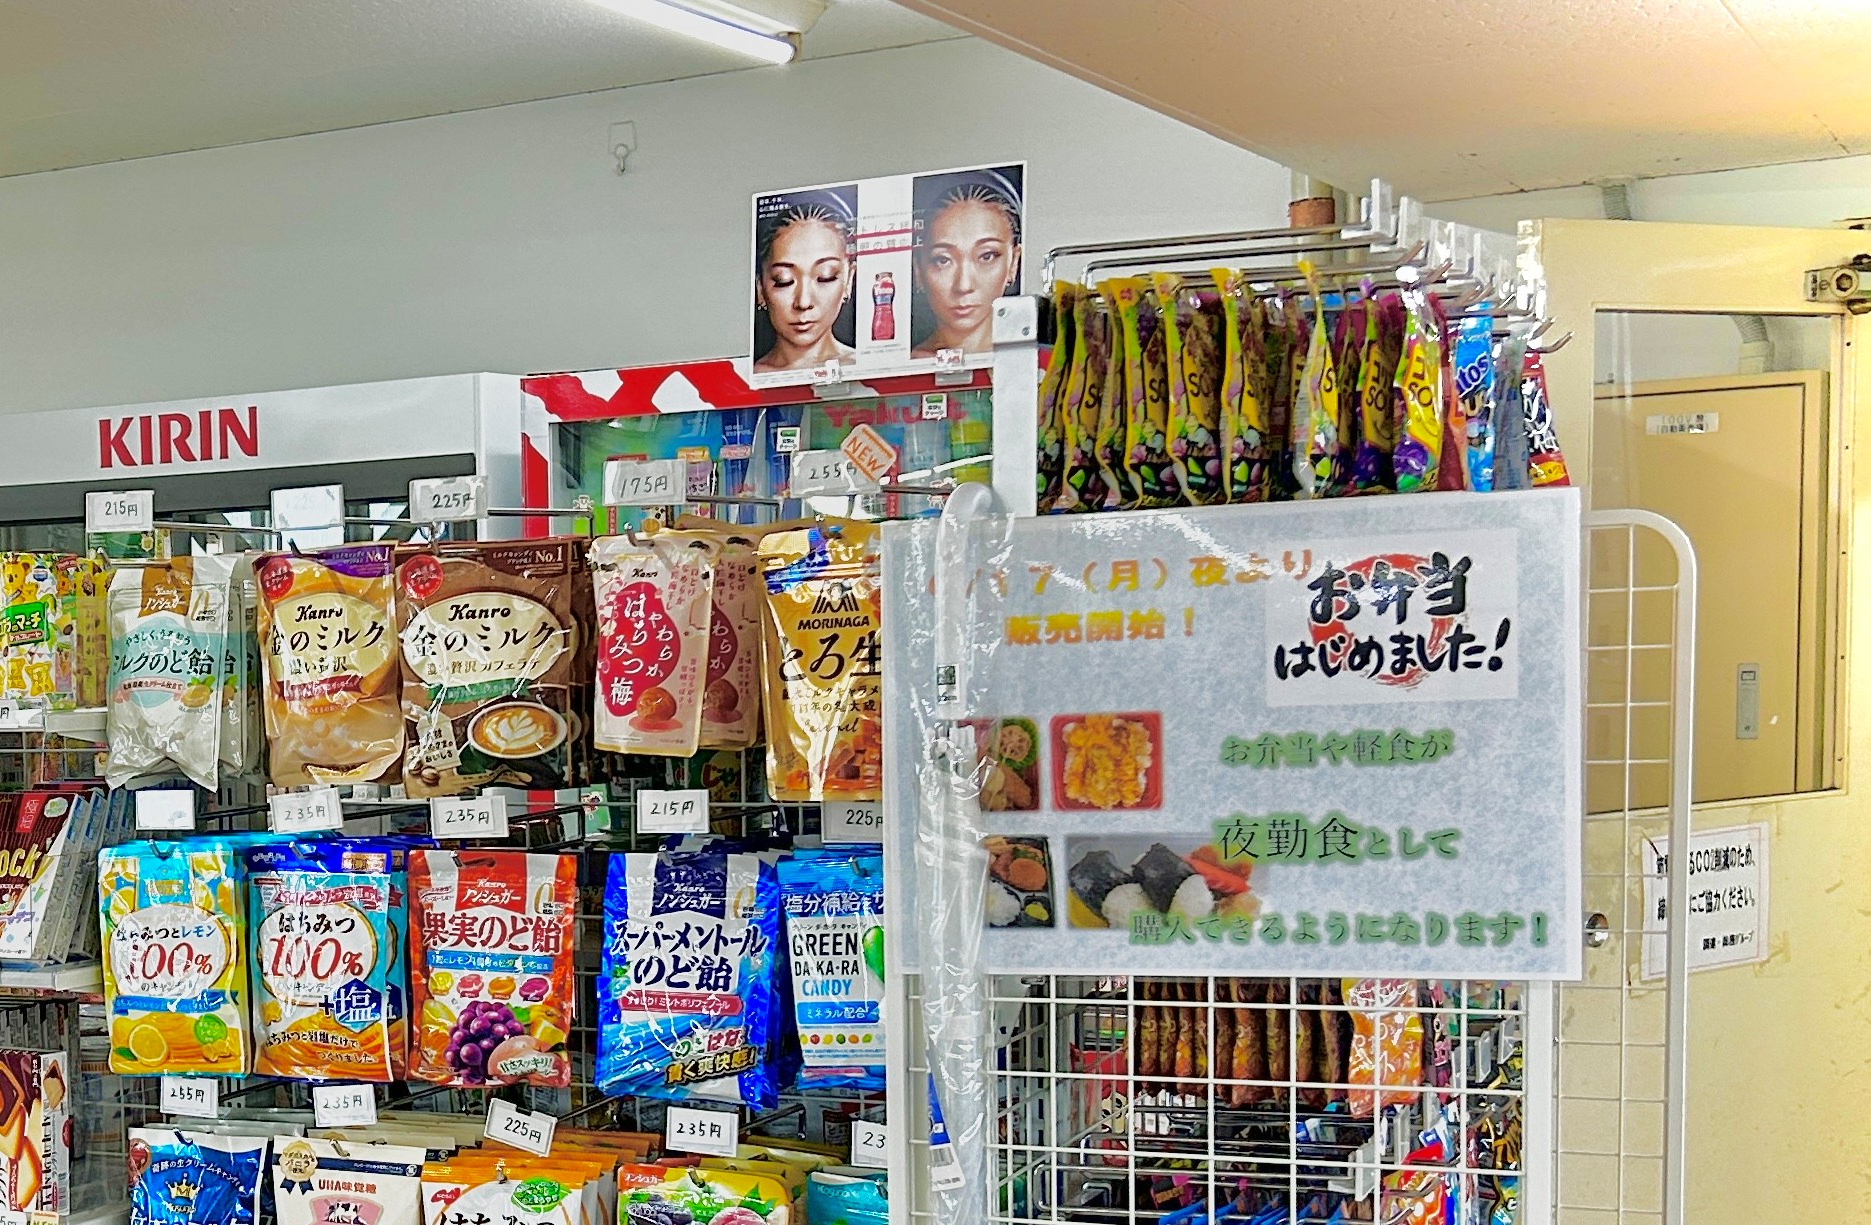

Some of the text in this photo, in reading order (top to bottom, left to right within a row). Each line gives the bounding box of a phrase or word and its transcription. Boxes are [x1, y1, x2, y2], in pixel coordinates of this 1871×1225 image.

[822, 399, 968, 427] Yakut
[98, 406, 258, 469] KIRIN
[847, 436, 883, 474] NEW
[621, 476, 668, 498] 175円
[106, 501, 138, 517] 215円
[535, 547, 563, 563] No.1
[1309, 551, 1472, 624] お弁当
[296, 604, 342, 623] Kanro
[448, 603, 511, 622] Kanro
[797, 616, 870, 631] MORINAGA
[1004, 607, 1195, 646] 販売開始！
[412, 621, 556, 656] 金のミルク
[646, 611, 674, 679] やわらか
[1274, 617, 1512, 684] はじめました!
[1224, 730, 1453, 768] お弁当や軽食が
[285, 805, 327, 821] 235円
[445, 809, 490, 824] 235円
[651, 802, 694, 816] 215円
[1219, 817, 1461, 862] 夜勤食として
[461, 888, 522, 906] ノンシュガー
[657, 892, 722, 909] ノンシュガー
[278, 912, 356, 935] はちみつ
[422, 911, 563, 953] 果実のど飴
[611, 921, 768, 957] スーパーメントール
[792, 933, 858, 958] GREEN
[270, 937, 364, 979] 100%
[634, 955, 733, 992] のど飴
[802, 979, 852, 997] CANDY
[807, 1007, 868, 1021] ミネラル配合
[171, 1086, 205, 1102] 255円
[323, 1095, 363, 1110] 235円
[504, 1117, 541, 1143] 225円
[677, 1122, 722, 1138] 235円
[318, 1179, 378, 1195] UHA味覚糖
